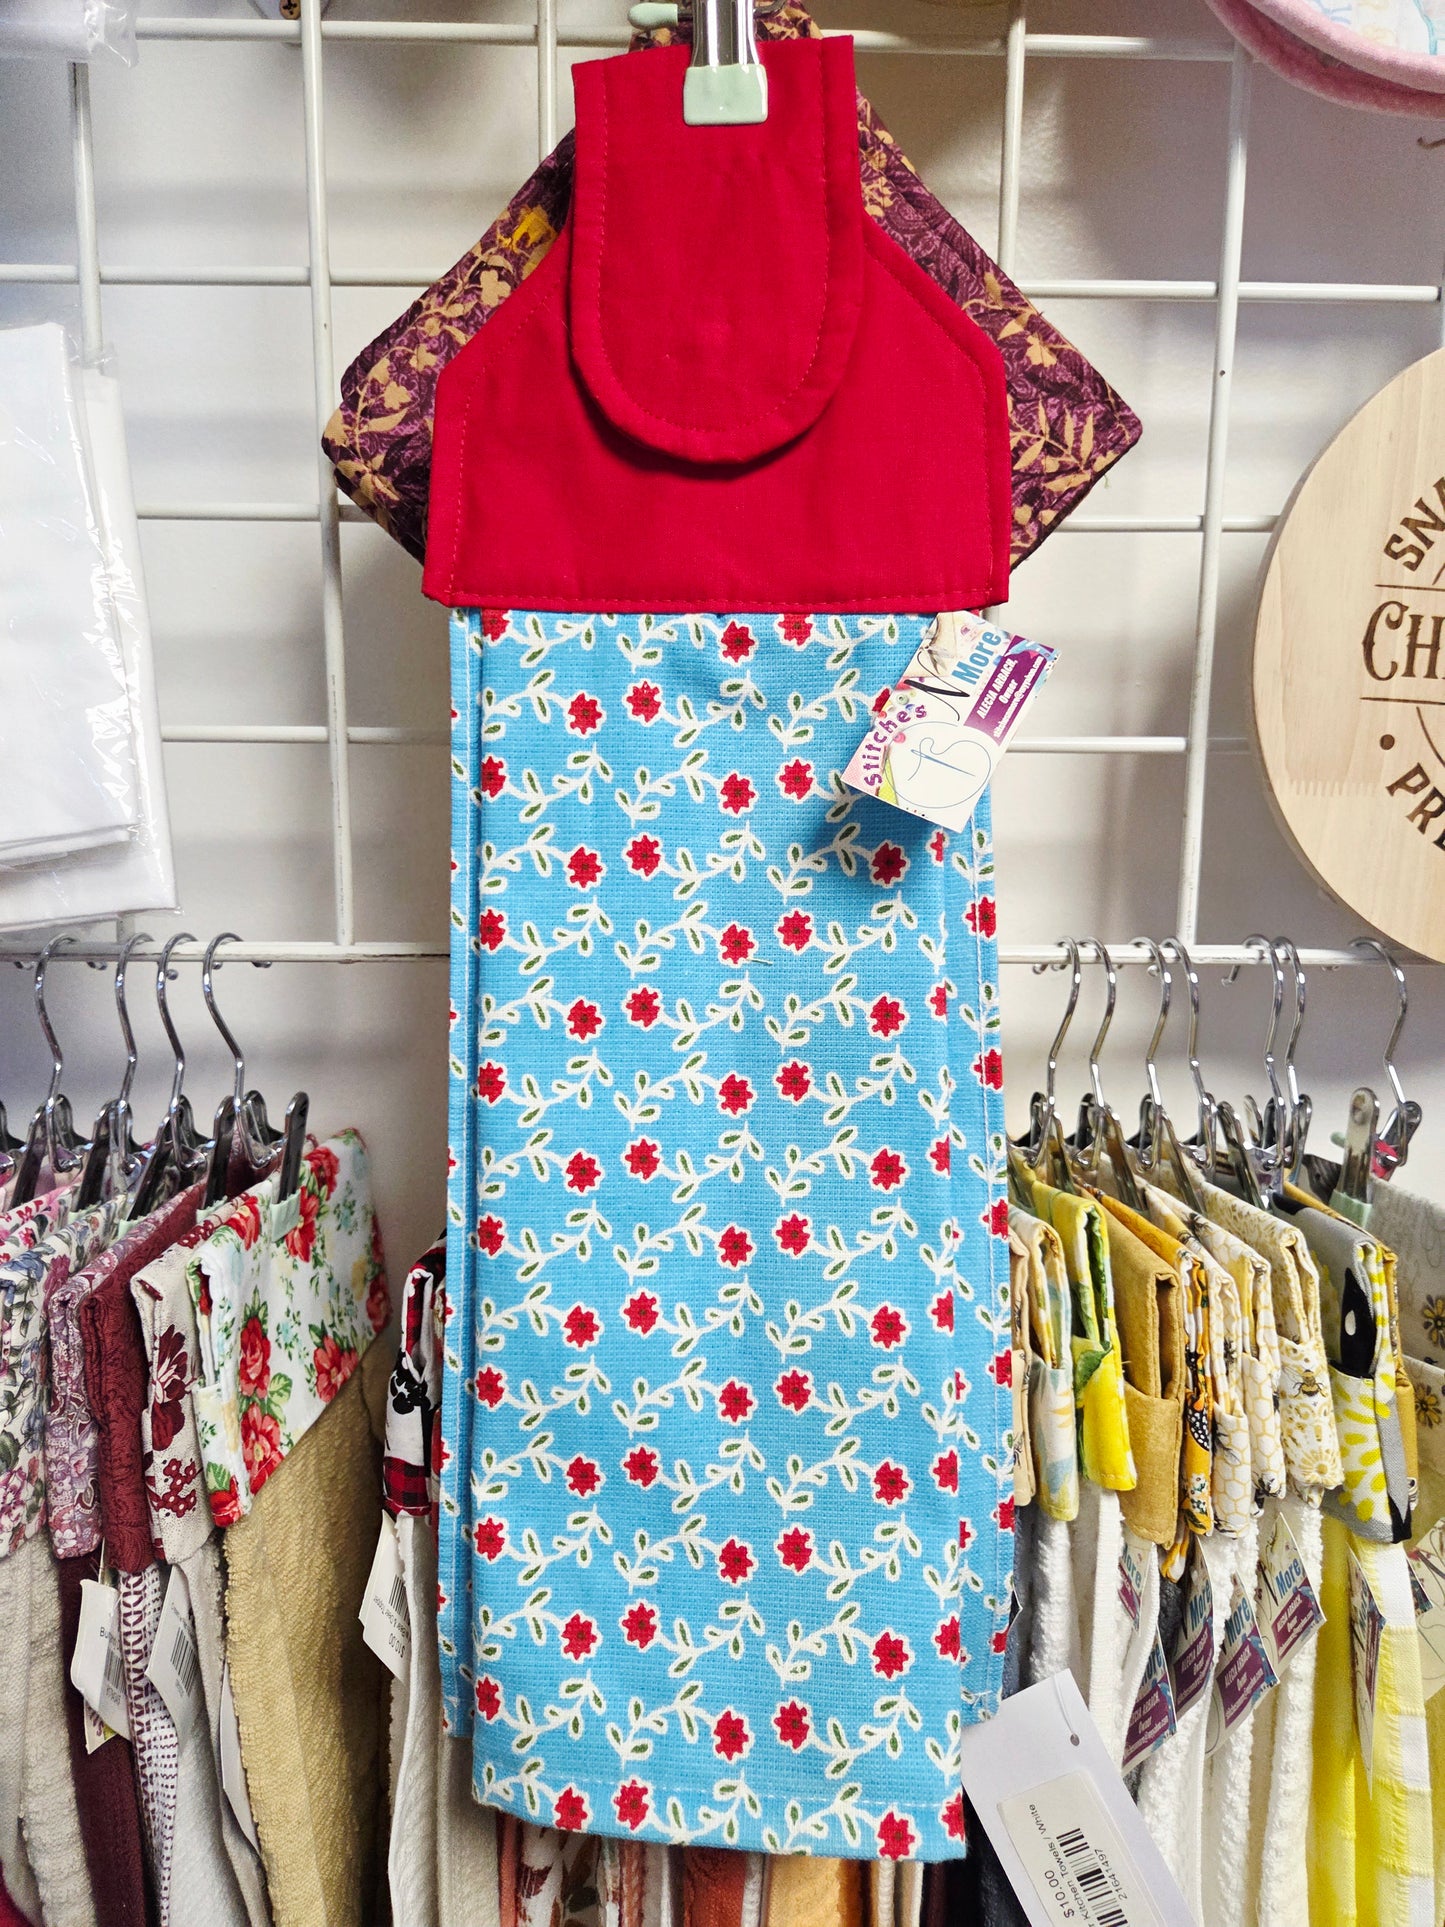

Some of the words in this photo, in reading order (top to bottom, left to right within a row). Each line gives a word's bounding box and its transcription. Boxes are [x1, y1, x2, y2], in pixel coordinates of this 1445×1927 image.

[1362, 600, 1445, 681] CH
[862, 704, 927, 786] Stitches
[951, 631, 1002, 686] More
[976, 689, 999, 719] ALECIA
[998, 679, 1018, 704] Owner
[1275, 1558, 1301, 1599] More
[1190, 1580, 1211, 1632] More
[1225, 1597, 1250, 1647] More
[1029, 1803, 1047, 1835] White
[1048, 1841, 1069, 1878] Towels
[1094, 1848, 1128, 1900] 21641497
[1044, 1870, 1075, 1918] $10.00
[1067, 1879, 1091, 1921] Kitchen
